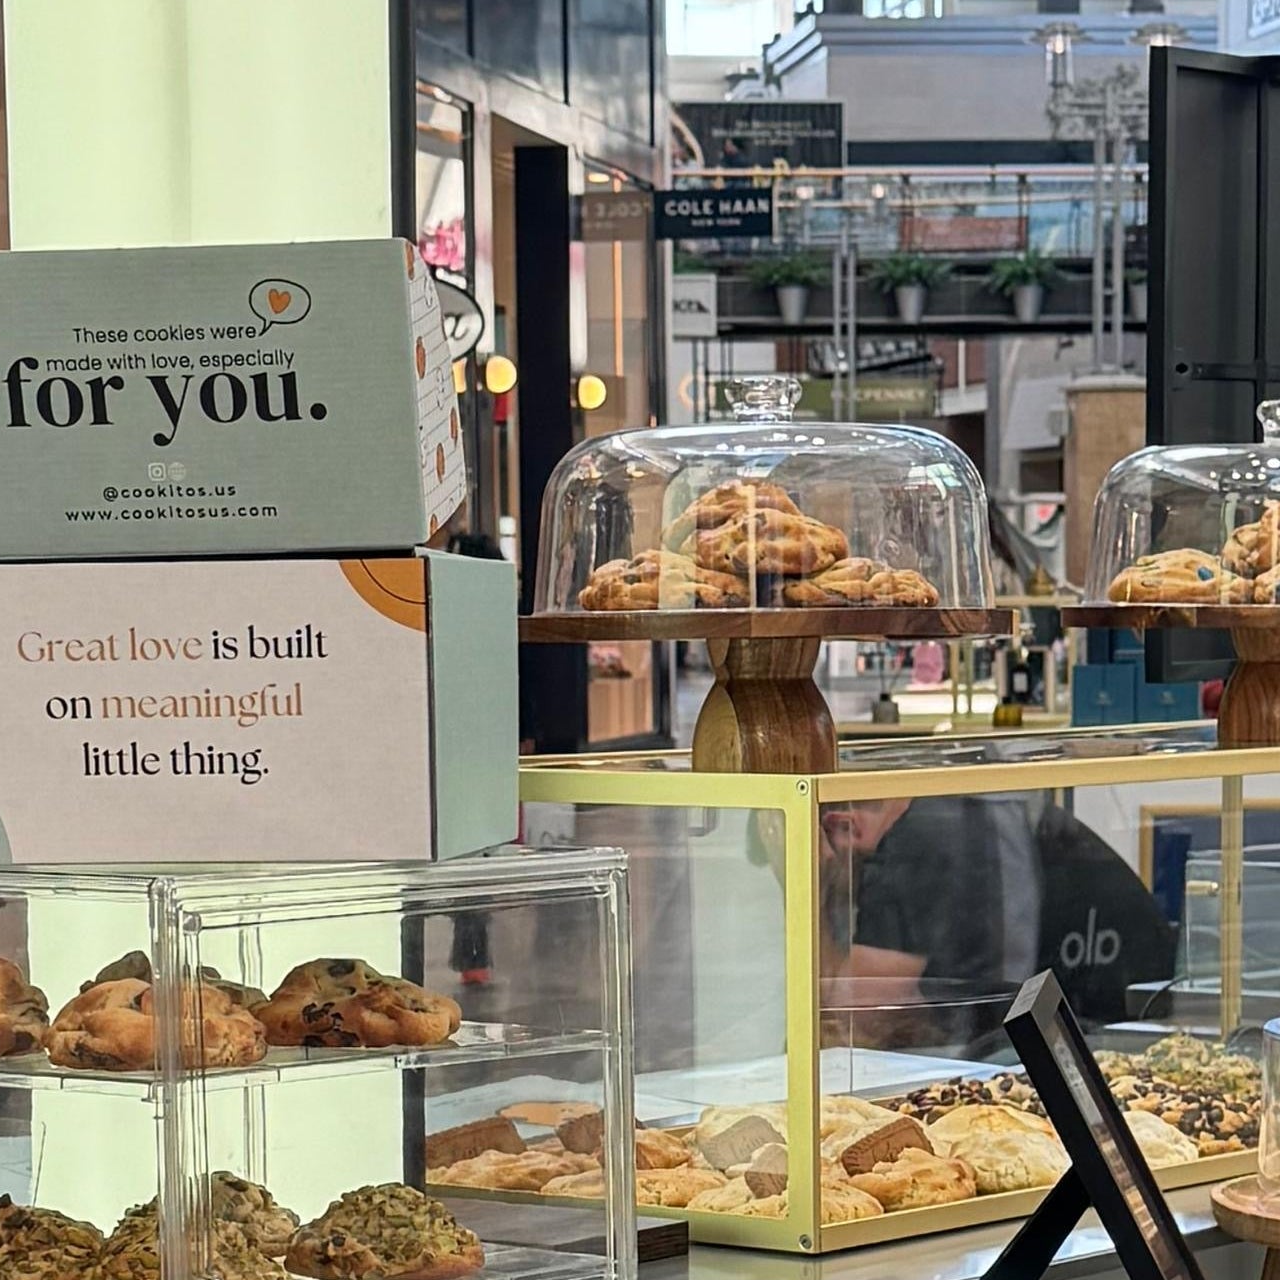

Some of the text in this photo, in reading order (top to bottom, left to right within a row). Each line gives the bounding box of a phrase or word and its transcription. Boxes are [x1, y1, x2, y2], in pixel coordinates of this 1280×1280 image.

[664, 198, 769, 217] COLE HAAN
[73, 325, 257, 345] These cookies were
[45, 348, 296, 372] made with love, especially
[1, 357, 328, 447] for you.
[102, 481, 237, 502] @cookitos.us
[64, 502, 278, 521] www.cookitosus.com
[17, 624, 329, 663] Great love is built
[45, 682, 304, 727] on meaningful
[81, 741, 270, 784] little thing.
